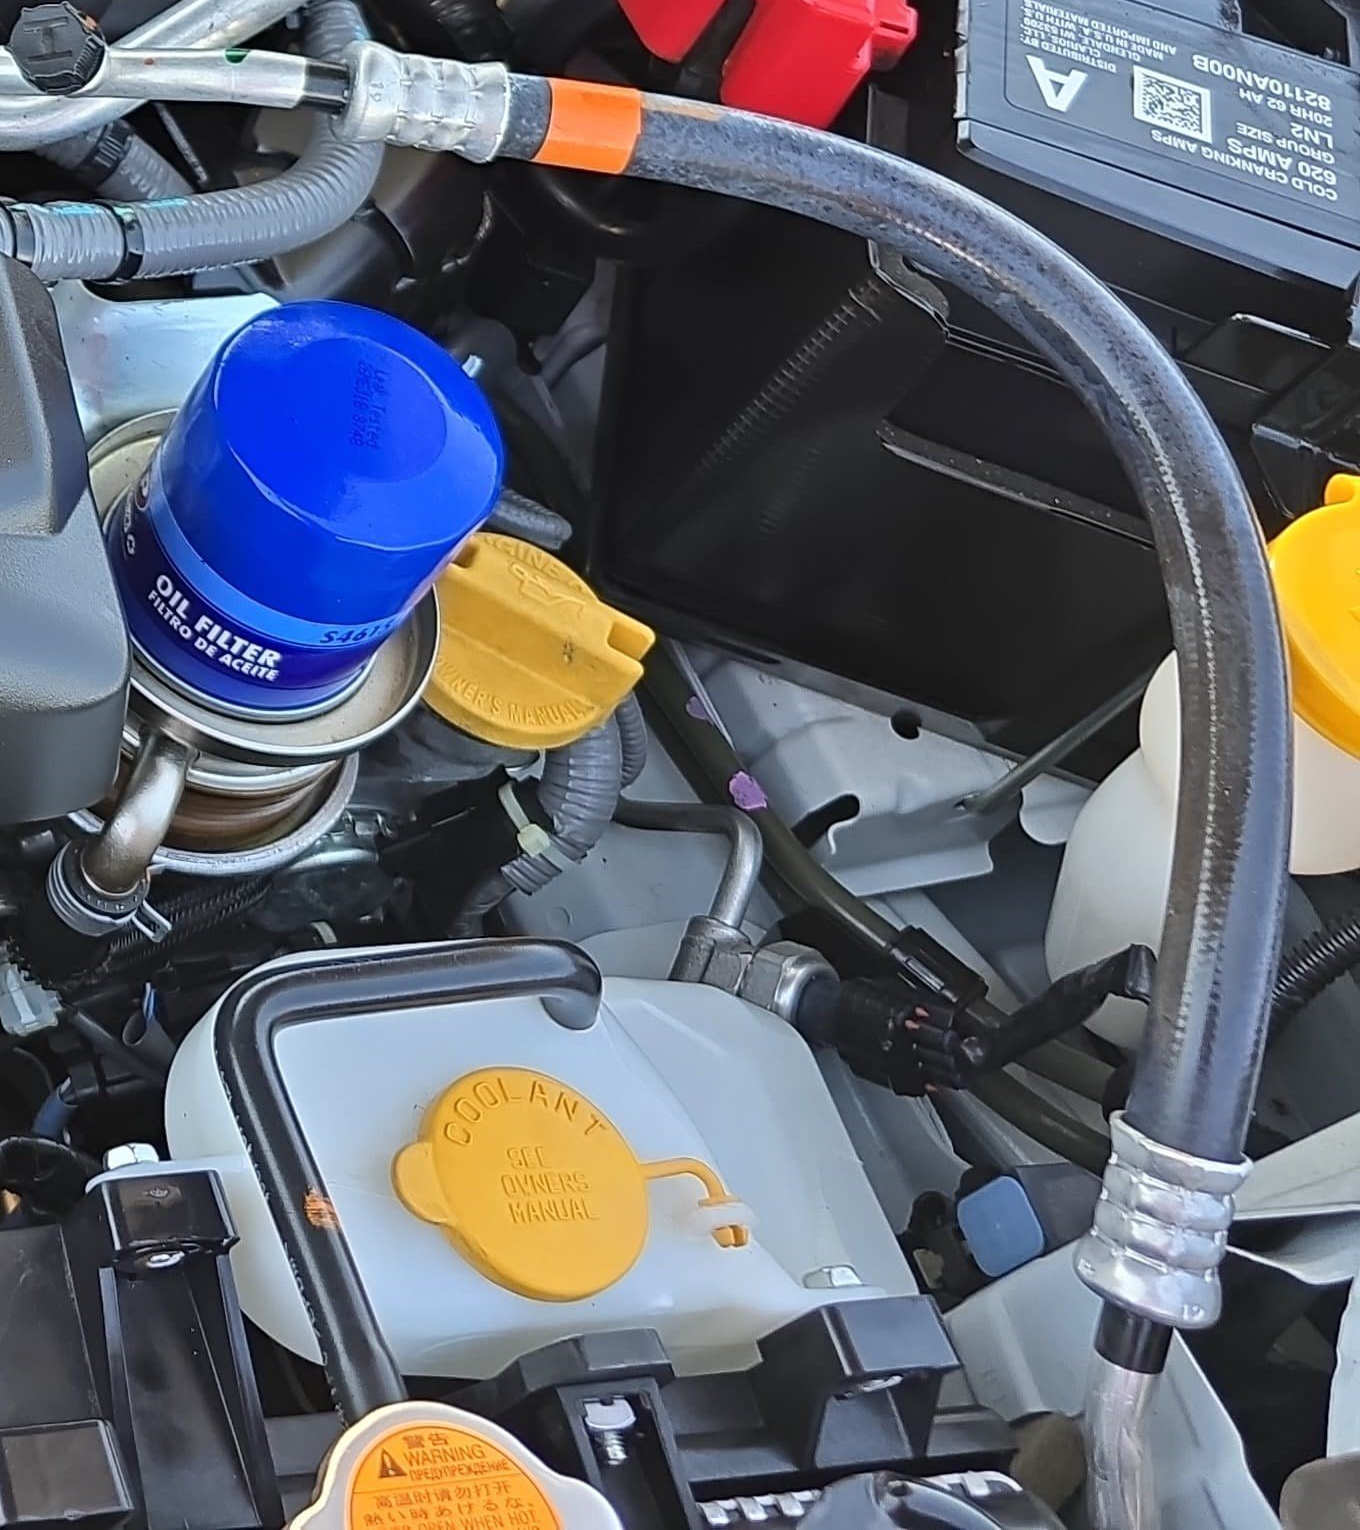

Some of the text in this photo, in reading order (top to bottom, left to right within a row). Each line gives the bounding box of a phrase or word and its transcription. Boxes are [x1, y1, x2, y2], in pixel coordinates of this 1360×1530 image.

[1045, 16, 1077, 33] WITH
[1061, 28, 1076, 41] WI
[1091, 19, 1151, 47] IMPORTED
[1019, 33, 1117, 74] DISTRIBUTED BY:
[1115, 37, 1128, 50] IN
[1130, 41, 1164, 62] MADE
[1153, 41, 1177, 55] AND
[1025, 53, 1089, 113] A
[1191, 53, 1332, 112] 82110AN00B
[1238, 87, 1334, 128] 20HR 62 AH
[1235, 122, 1336, 165] GROUP SIZE
[1289, 121, 1334, 151] LN2
[1150, 129, 1338, 202] COLD CRANKING AMPS
[1226, 137, 1337, 186] 620 AMPS
[155, 574, 282, 668] OIL FILTER
[147, 590, 281, 682] FILTRO DE ACEITE
[507, 700, 586, 727] MANUAL
[443, 1076, 607, 1147] COOLANT
[506, 1145, 552, 1170] SEE
[499, 1171, 591, 1198] OWNERS
[507, 1197, 601, 1226] MANUAL
[402, 1431, 450, 1449] 警告
[403, 1443, 486, 1467] WARNING
[409, 1458, 510, 1481] ПРЕДУПРЕЖДЕНИЕ
[373, 1480, 512, 1509] 高温时请勿打开
[460, 1513, 504, 1530] WHEN
